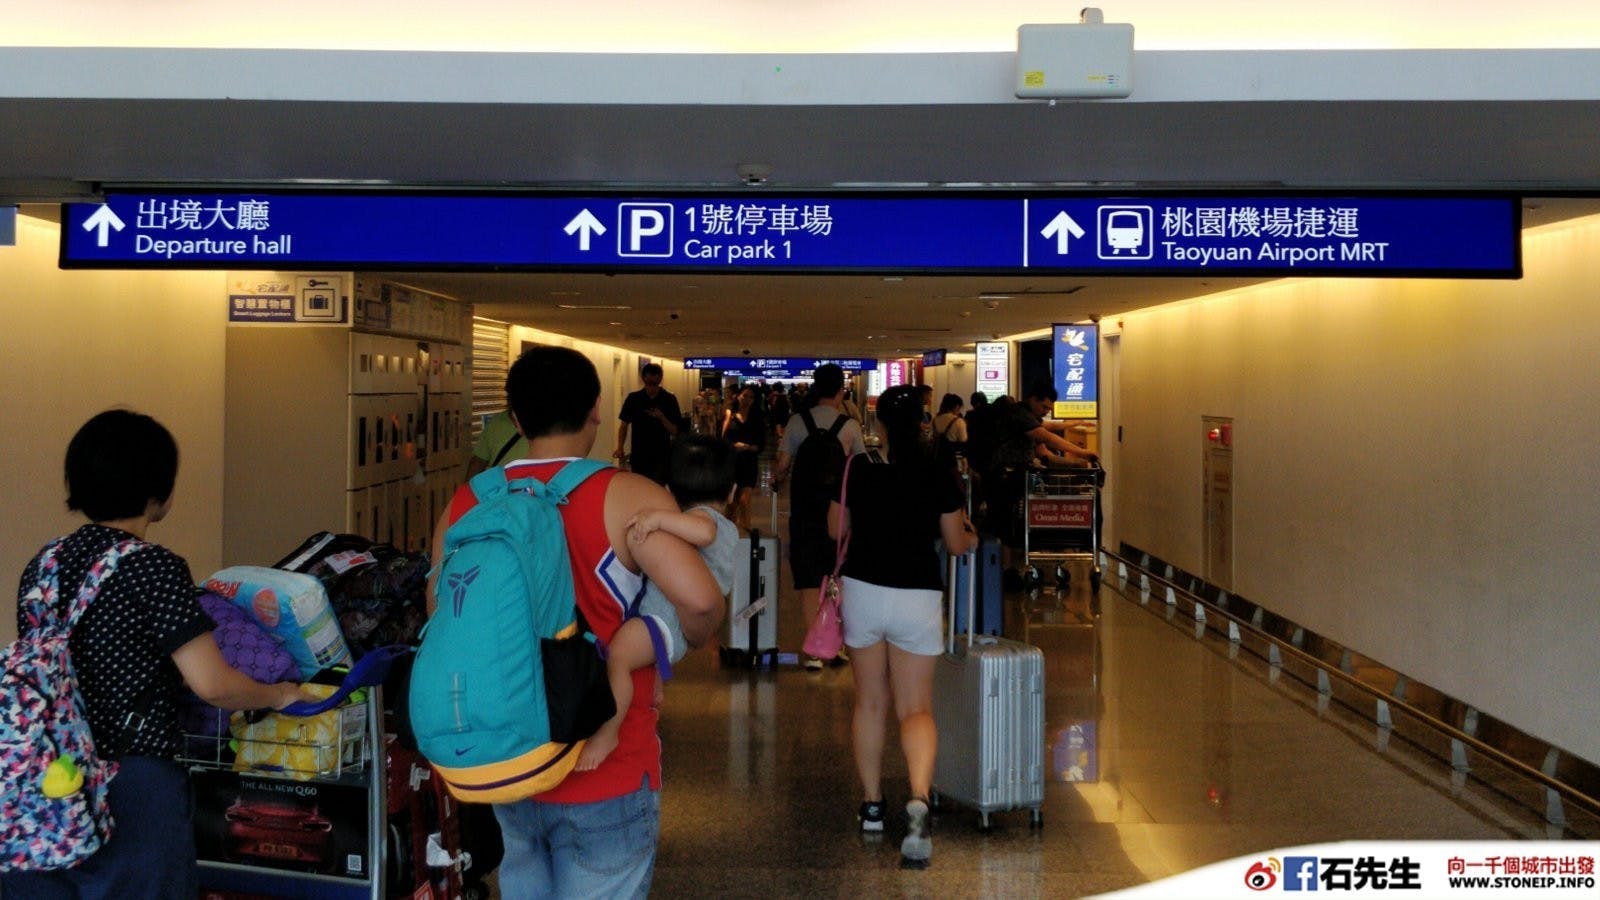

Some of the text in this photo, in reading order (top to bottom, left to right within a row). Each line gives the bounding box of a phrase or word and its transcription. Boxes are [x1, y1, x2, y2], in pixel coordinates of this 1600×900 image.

[136, 198, 270, 231] 出境大廳
[684, 203, 833, 236] 1號停車場
[1161, 206, 1359, 238] 桃園機場捷運
[630, 208, 665, 251] P
[135, 234, 291, 259] Departure hall
[684, 239, 791, 263] Car park 1
[1161, 241, 1389, 266] Taoyuan Airport MRT
[1060, 512, 1085, 521] Media
[241, 781, 318, 797] THE ALL NEW Q60
